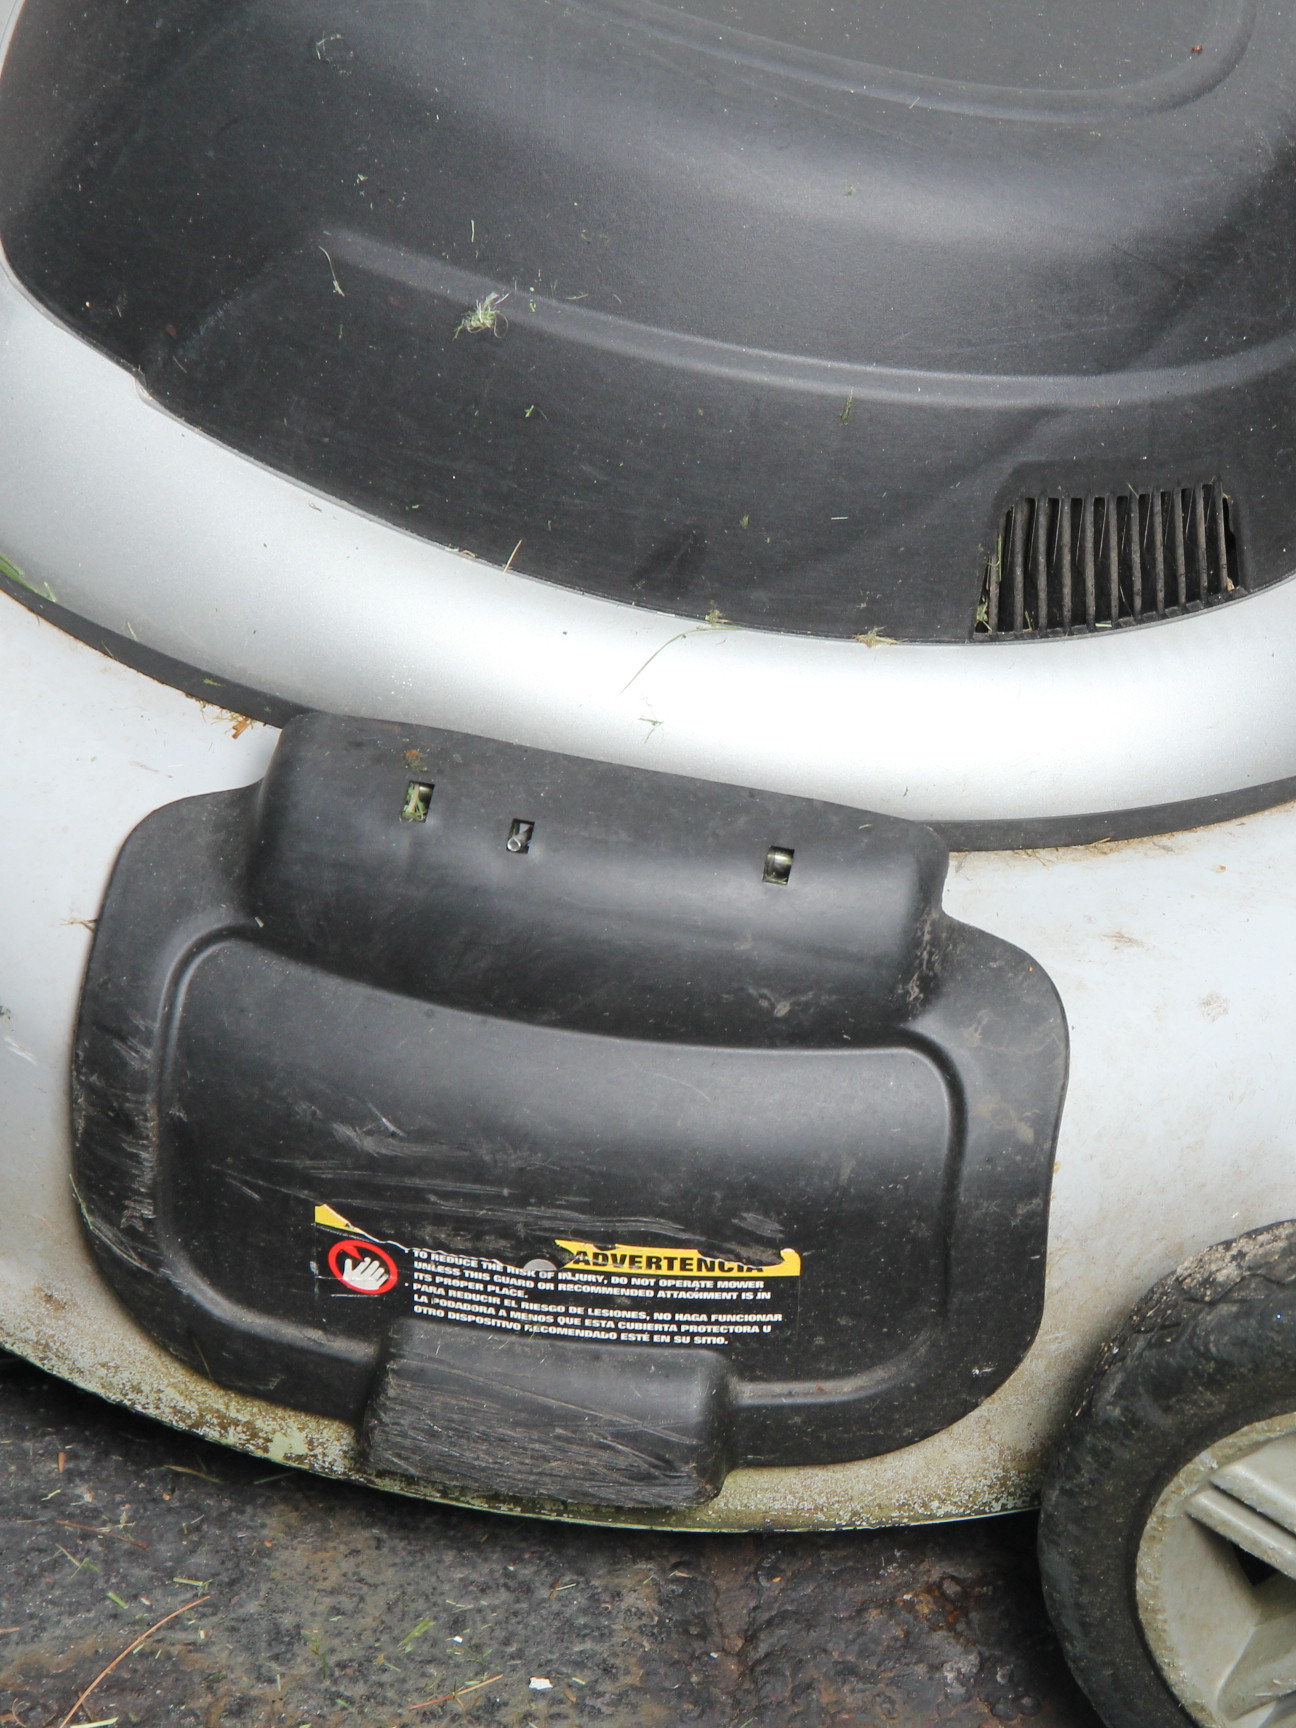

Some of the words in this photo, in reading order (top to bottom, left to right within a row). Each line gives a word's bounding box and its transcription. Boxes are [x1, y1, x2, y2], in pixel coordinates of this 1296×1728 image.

[413, 1249, 428, 1259] TO
[431, 1253, 478, 1268] REDUCE
[481, 1261, 504, 1272] THE
[506, 1265, 536, 1278] RISK
[538, 1269, 554, 1279] OF
[558, 1271, 608, 1284] INJURY,
[611, 1276, 628, 1285] DO
[631, 1277, 656, 1286] NOT
[659, 1279, 713, 1289] OPERATE
[717, 1280, 764, 1289] MOWER
[414, 1261, 461, 1276] UNLESS
[463, 1269, 490, 1281] THIS
[493, 1274, 534, 1288] GUARD
[537, 1280, 555, 1290] OR
[558, 1283, 654, 1297] RECOMMENDED
[741, 1291, 754, 1300] IS
[756, 1291, 771, 1300] IN
[414, 1272, 433, 1282] ITS
[435, 1275, 484, 1291] PROPER
[487, 1284, 529, 1298] PLACE.
[413, 1283, 446, 1296] PARA
[448, 1288, 500, 1305] REDUCIR
[504, 1298, 518, 1308] EL
[521, 1301, 565, 1313] RIESGO
[568, 1305, 585, 1314] DE
[588, 1307, 650, 1320] LESIONES,
[653, 1312, 671, 1320] NO
[675, 1313, 708, 1322] HAGA
[711, 1314, 782, 1322] FUNCIONAR
[414, 1294, 429, 1304] LA
[498, 1308, 508, 1317] A
[509, 1310, 554, 1323] MENOS
[557, 1315, 581, 1326] QUE
[585, 1318, 615, 1329] ESTA
[618, 1321, 678, 1332] CUBIERTA
[681, 1324, 760, 1334] PROTECTORA
[762, 1325, 771, 1333] U
[414, 1305, 444, 1318] OTRO
[448, 1311, 521, 1331] DISPOSITIVO
[620, 1331, 650, 1342] ESTÉ
[653, 1334, 671, 1343] EN
[674, 1335, 690, 1344] SU
[694, 1336, 728, 1345] SITIO.
